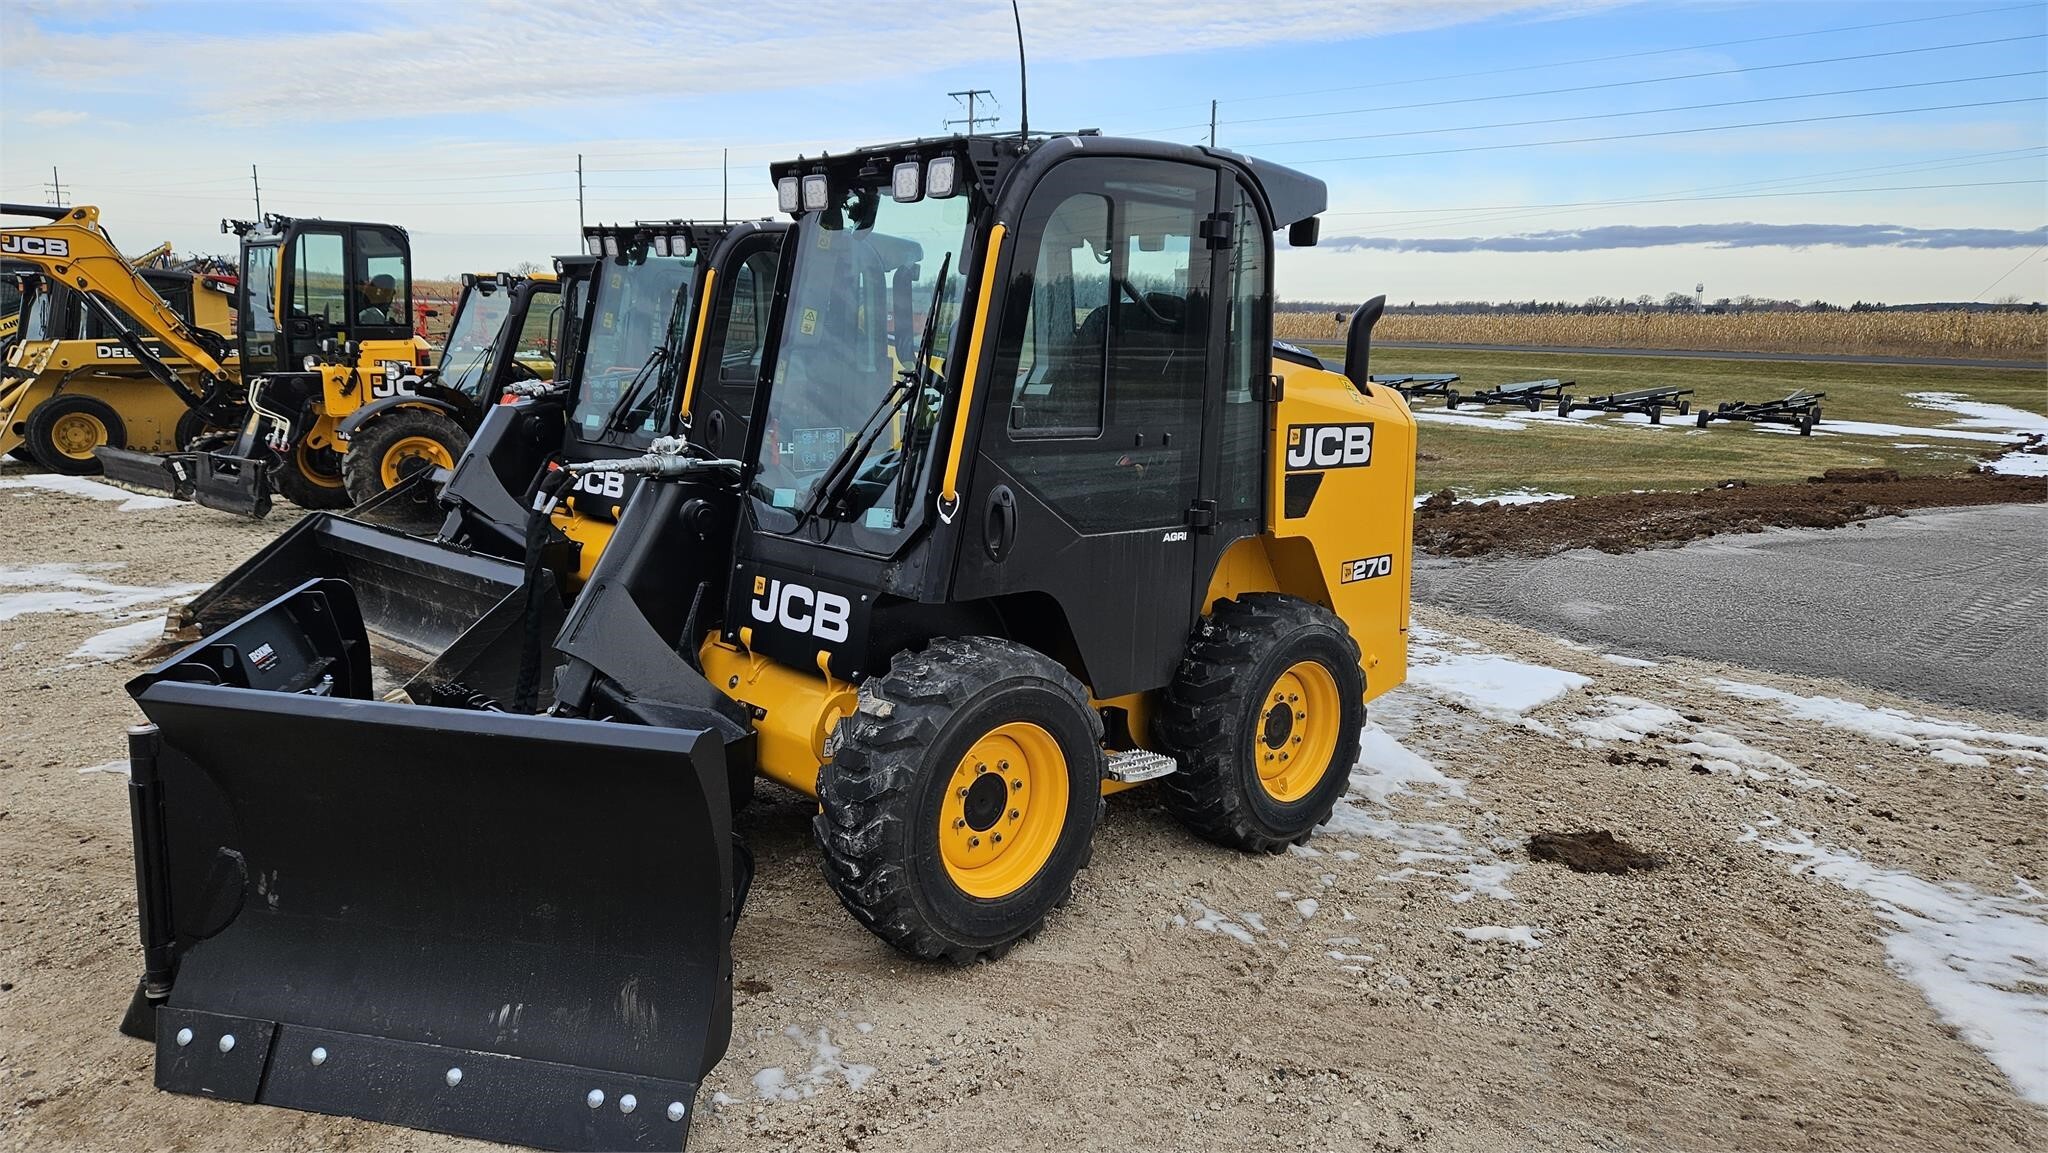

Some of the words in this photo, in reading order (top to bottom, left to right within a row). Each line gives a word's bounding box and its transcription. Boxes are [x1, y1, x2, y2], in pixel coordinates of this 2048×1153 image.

[1, 236, 69, 257] JCB
[373, 375, 432, 398] JC
[1288, 426, 1372, 468] JCB
[1162, 531, 1187, 543] AGRI
[1352, 555, 1391, 581] 270
[751, 579, 851, 643] JCB
